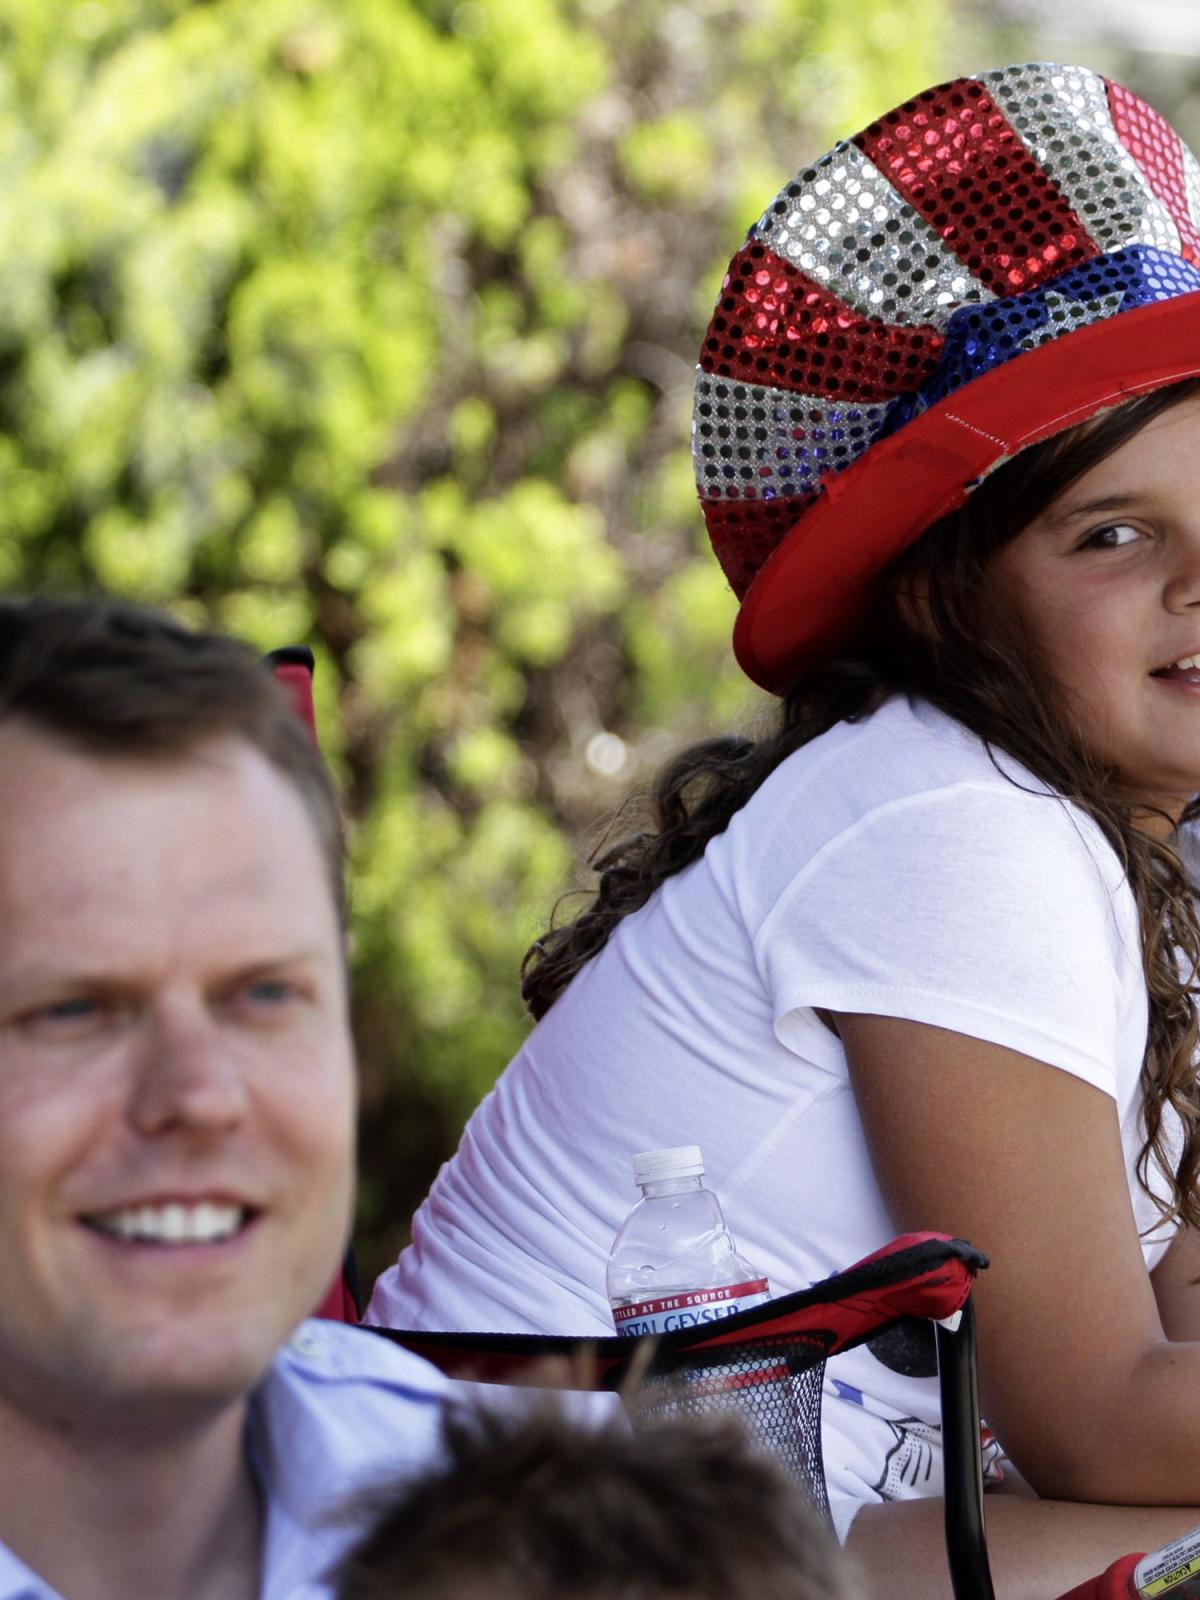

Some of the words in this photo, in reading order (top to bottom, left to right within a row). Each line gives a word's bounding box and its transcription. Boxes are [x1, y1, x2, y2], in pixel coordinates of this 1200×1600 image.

[642, 1303, 655, 1313] AT
[660, 1298, 680, 1310] THE
[686, 1289, 732, 1305] SOURCE
[1163, 1567, 1188, 1585] CAUTION
